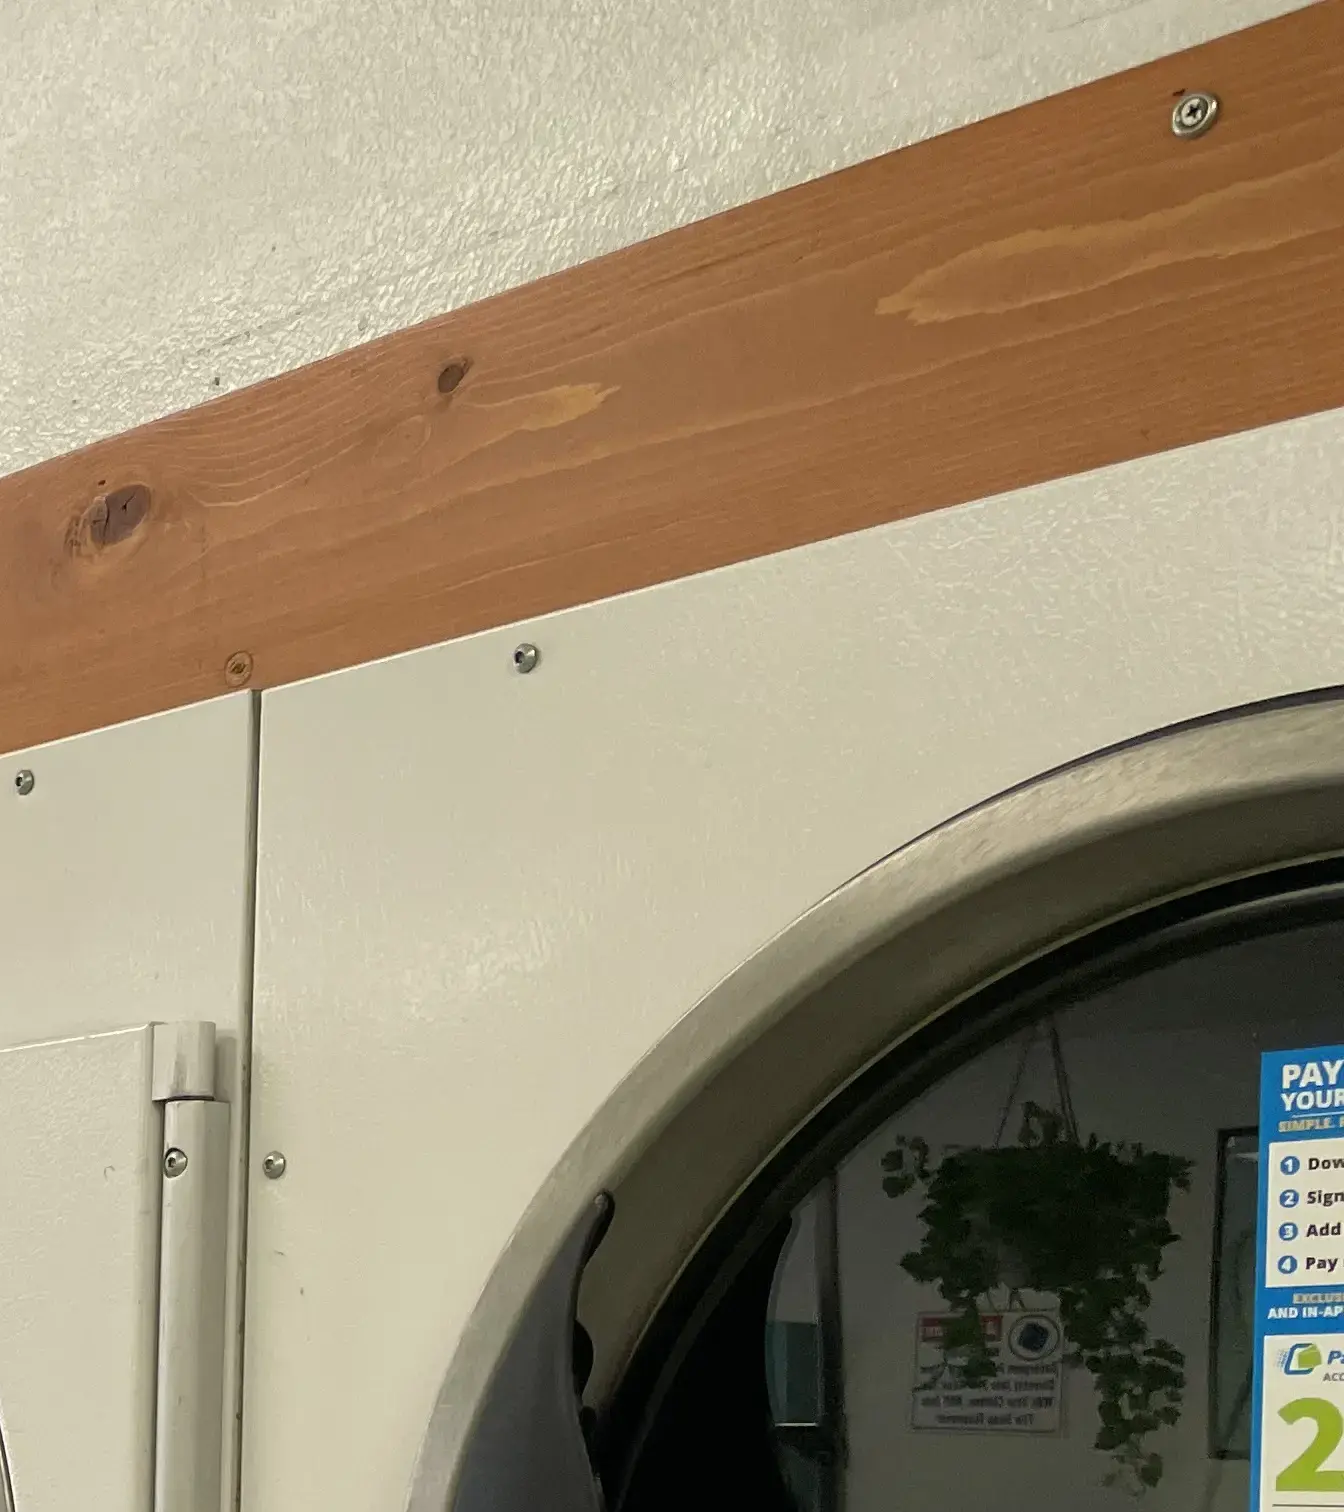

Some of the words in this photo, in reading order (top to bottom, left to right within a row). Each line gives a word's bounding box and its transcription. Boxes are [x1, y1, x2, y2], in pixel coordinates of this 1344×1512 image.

[1282, 1060, 1344, 1088] PAY
[1307, 1190, 1344, 1207] Sign
[1306, 1222, 1341, 1237] Add
[1306, 1257, 1338, 1272] Pay
[1268, 1307, 1298, 1319] AND
[1277, 1397, 1344, 1492] 2
